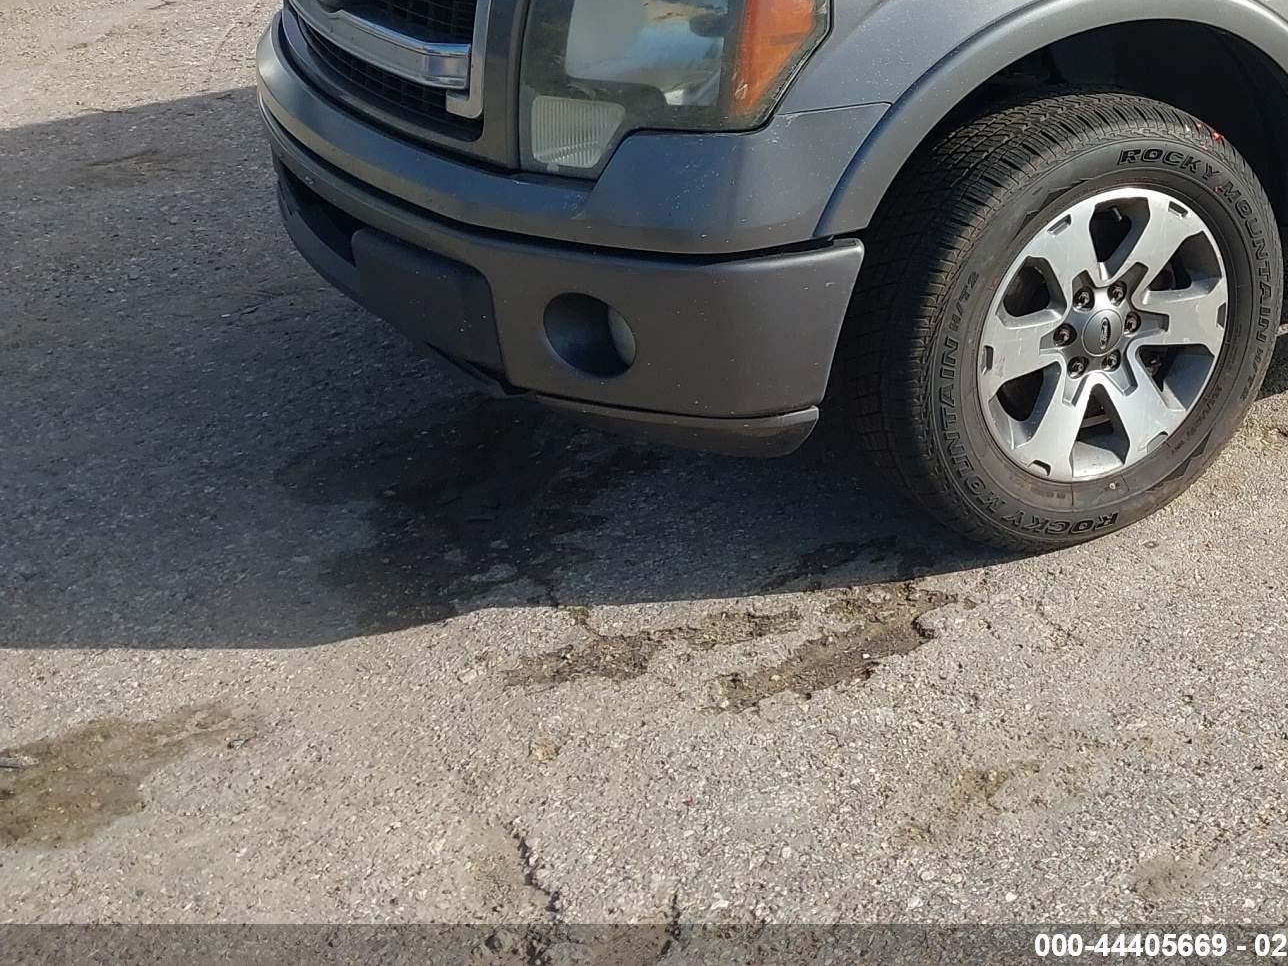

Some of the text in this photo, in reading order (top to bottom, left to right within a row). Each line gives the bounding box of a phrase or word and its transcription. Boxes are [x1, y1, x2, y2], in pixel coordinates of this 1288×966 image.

[1116, 148, 1220, 181] ROCKY
[1221, 180, 1272, 344] MOUNTAIN
[939, 336, 1007, 515] MOUNTAIN
[1001, 509, 1120, 535] ROCKY
